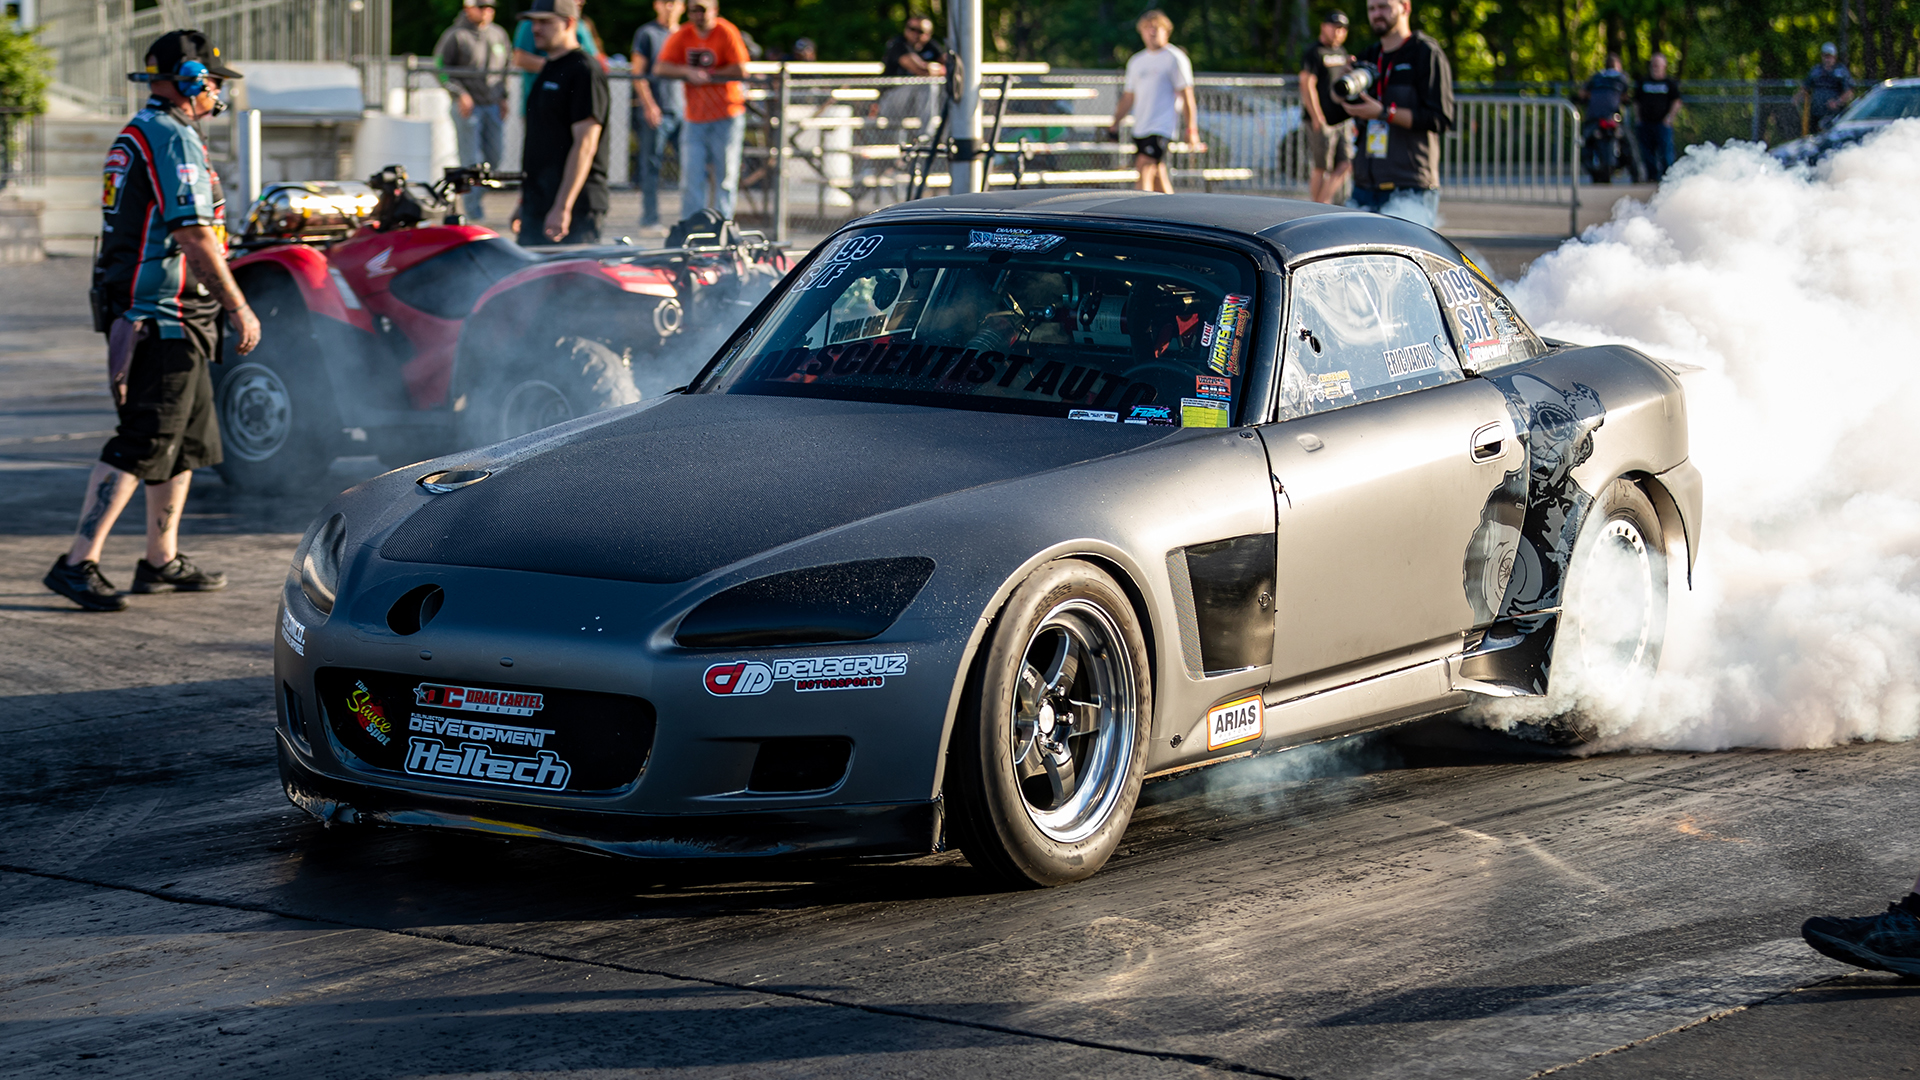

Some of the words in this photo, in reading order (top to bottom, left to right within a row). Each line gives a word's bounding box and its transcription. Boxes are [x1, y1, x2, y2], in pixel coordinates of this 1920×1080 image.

[995, 227, 1033, 235] DIAMOND
[791, 262, 852, 293] S/F
[1434, 266, 1480, 308] J199
[1209, 329, 1232, 376] LIGHTS
[1221, 303, 1239, 327] OUT
[1456, 303, 1493, 342] S/F
[802, 342, 1034, 388] SCIENTIST
[1023, 360, 1158, 411] AUTO
[1384, 349, 1408, 377] ERIC
[1407, 343, 1437, 374] JARVIS
[466, 690, 500, 706] DRAG
[498, 692, 542, 709] CARTEL
[797, 676, 883, 690] MOTORSPORTS
[345, 689, 392, 733] Sauce
[1214, 705, 1257, 735] ARIAS
[408, 717, 556, 748] DEVELOPMENT
[407, 740, 567, 786] Haltech
